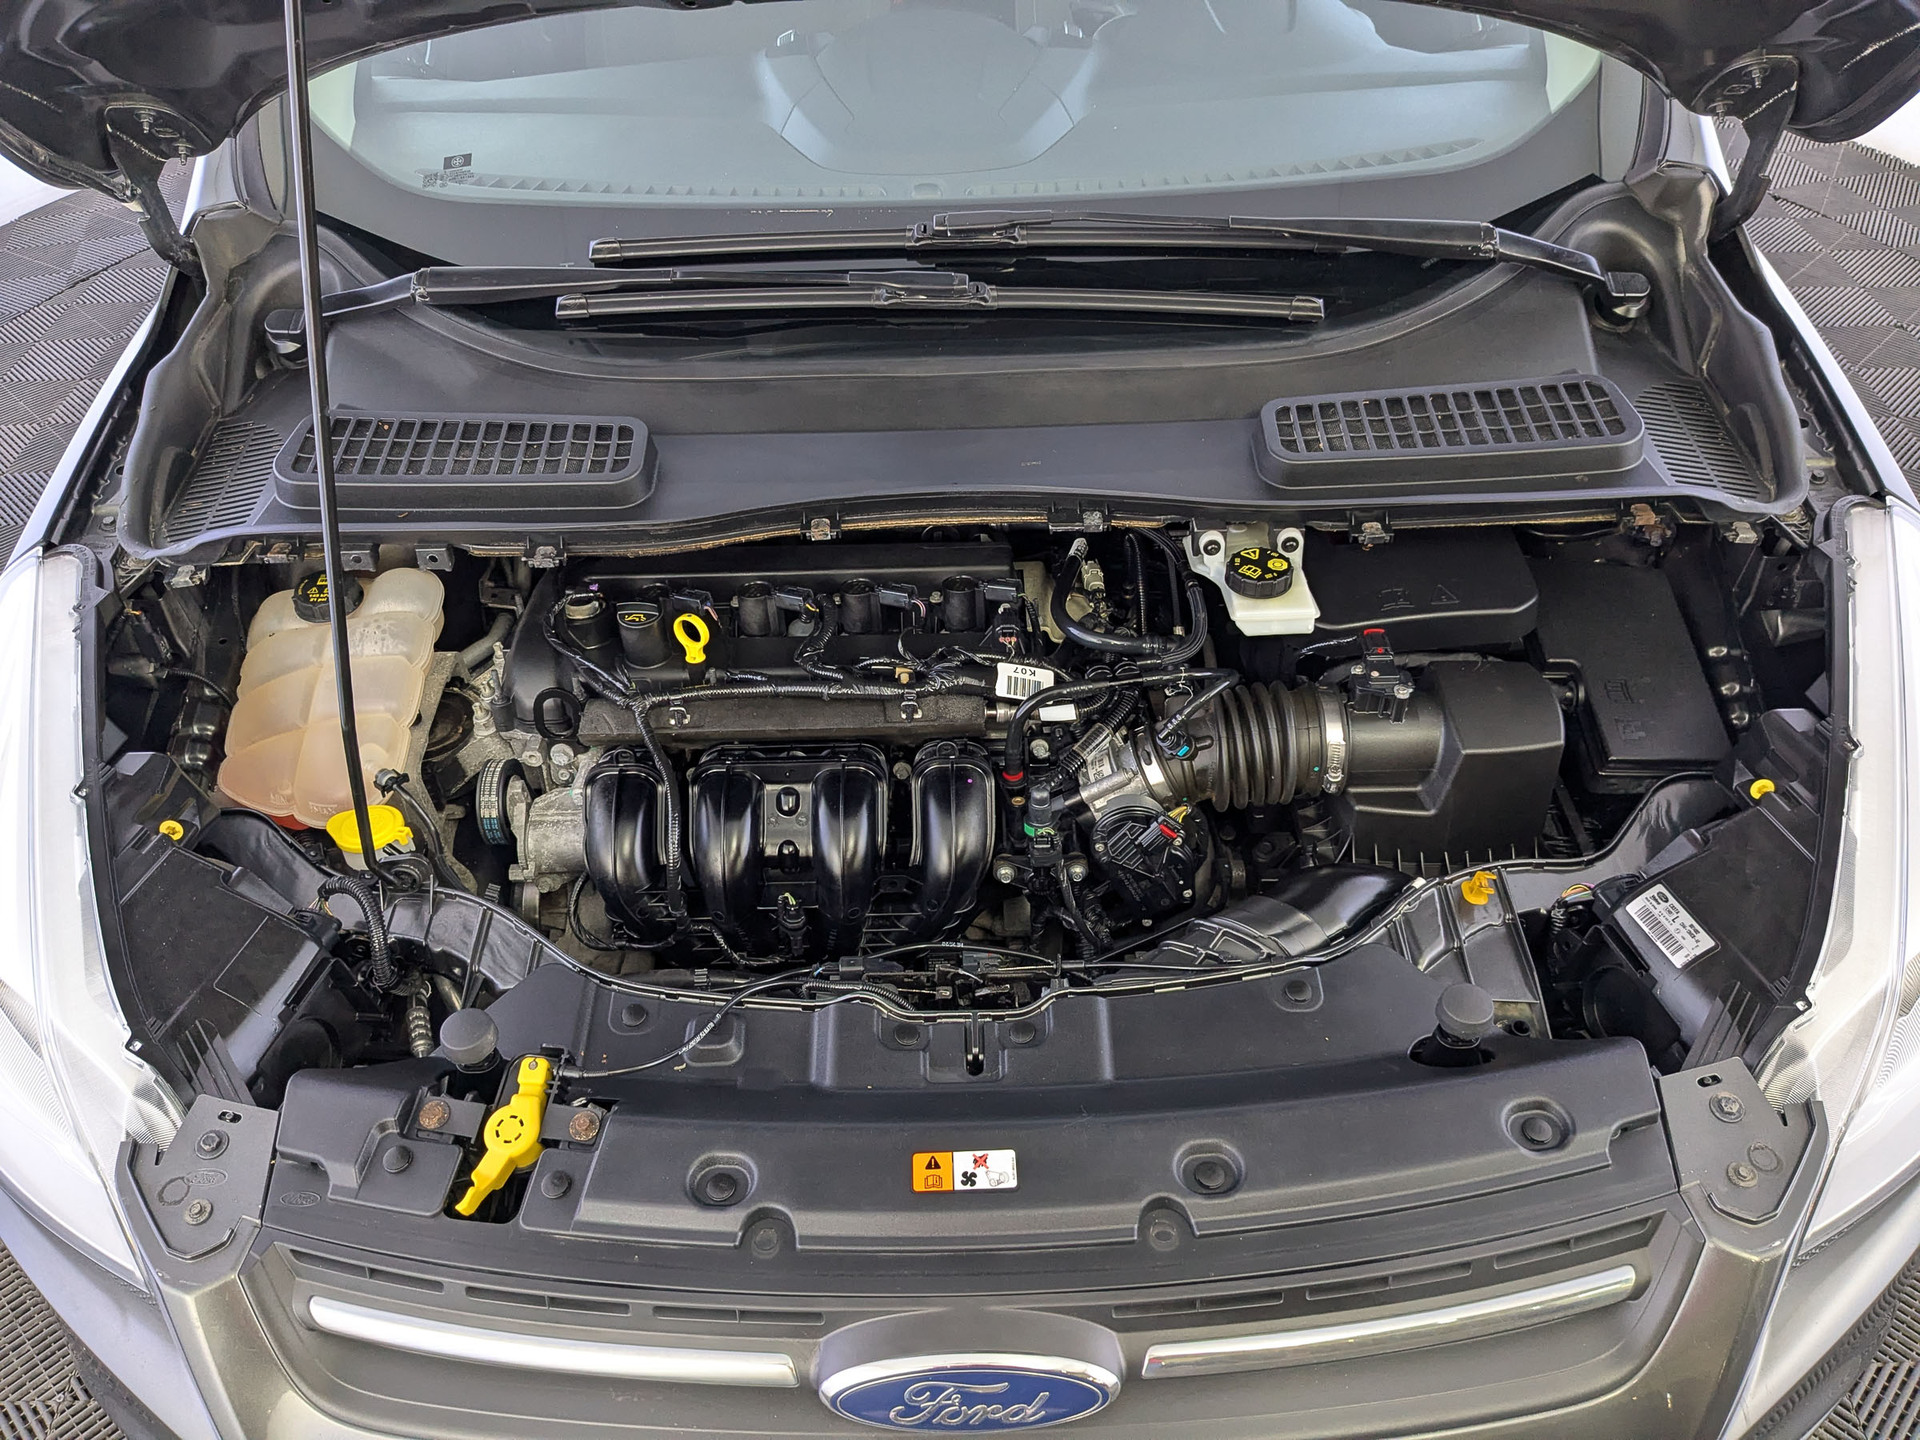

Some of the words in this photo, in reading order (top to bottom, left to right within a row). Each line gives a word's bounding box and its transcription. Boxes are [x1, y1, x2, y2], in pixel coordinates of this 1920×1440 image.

[1013, 667, 1036, 677] K07
[1671, 915, 1680, 923] L
[889, 1381, 1049, 1425] Ford
